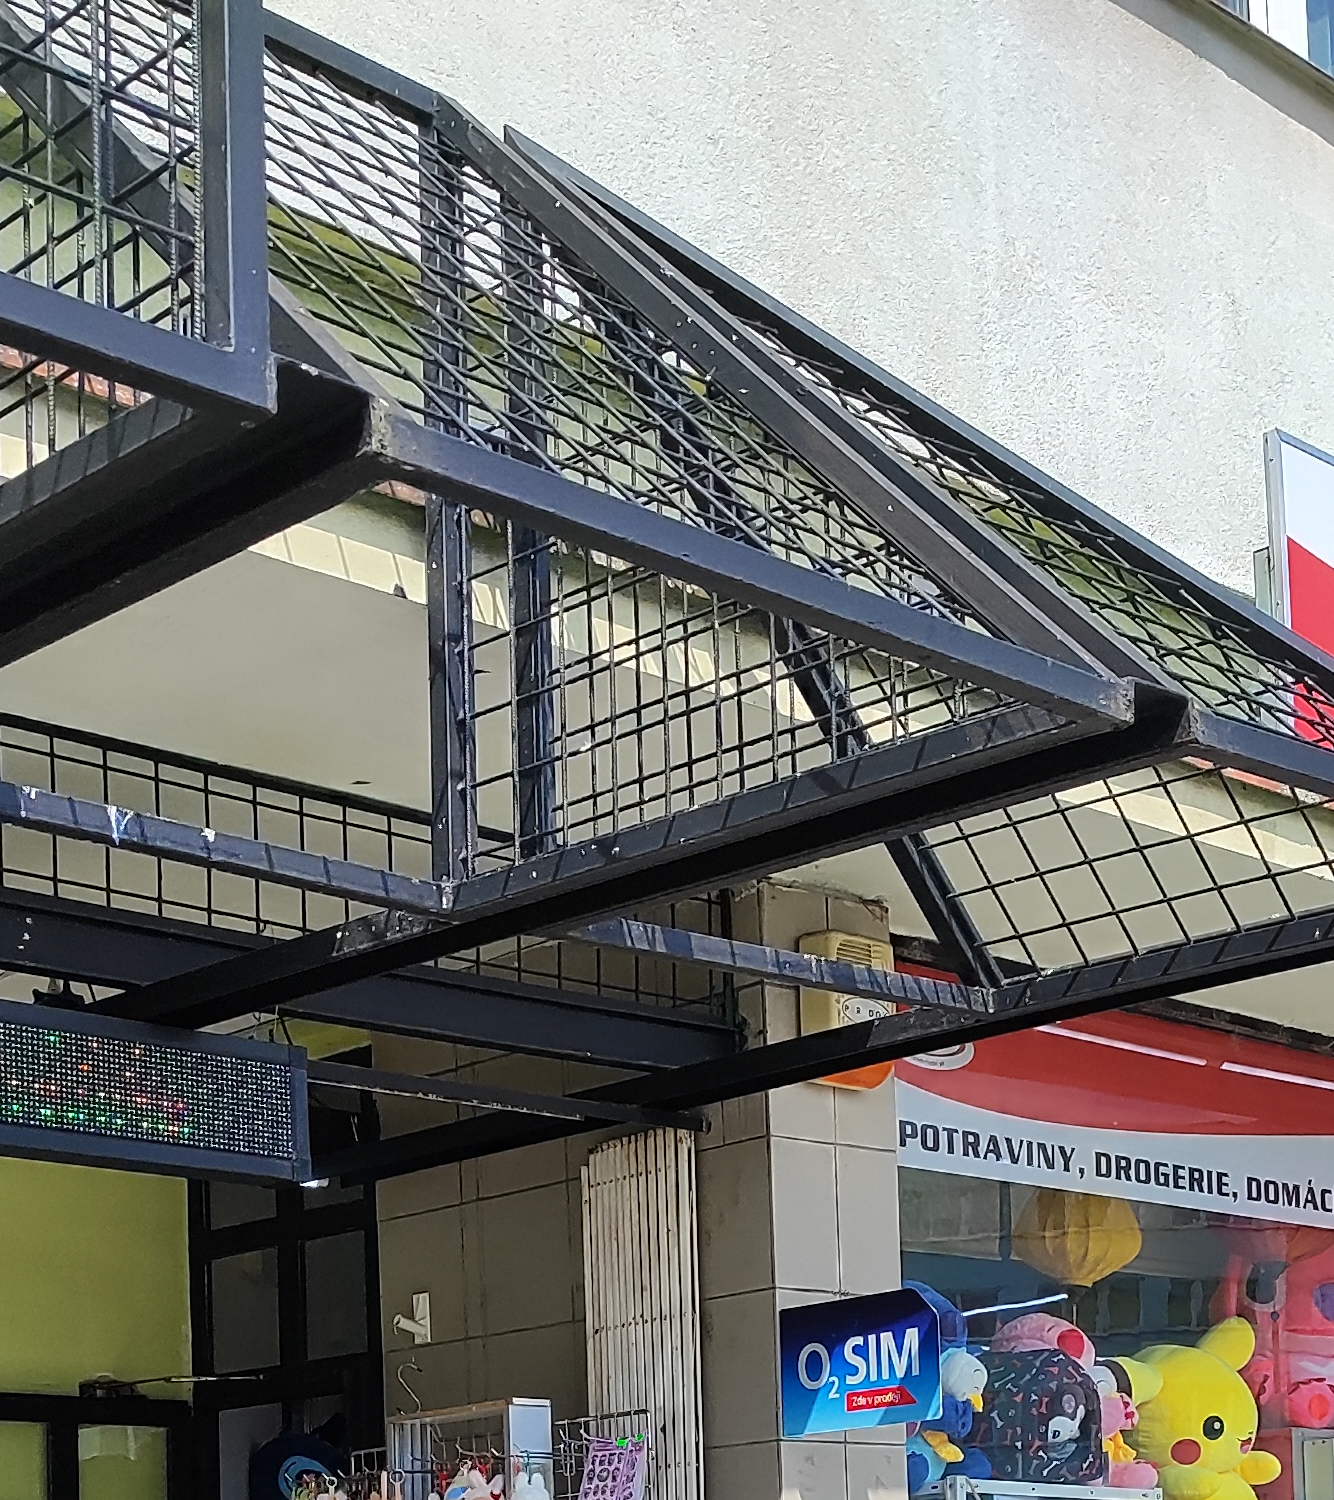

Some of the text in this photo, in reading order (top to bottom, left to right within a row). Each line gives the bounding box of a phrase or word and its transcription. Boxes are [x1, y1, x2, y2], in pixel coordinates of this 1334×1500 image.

[898, 1119, 1086, 1179] POTRAVINY,
[1094, 1151, 1239, 1204] DROGERIE,
[844, 1326, 920, 1385] SIM
